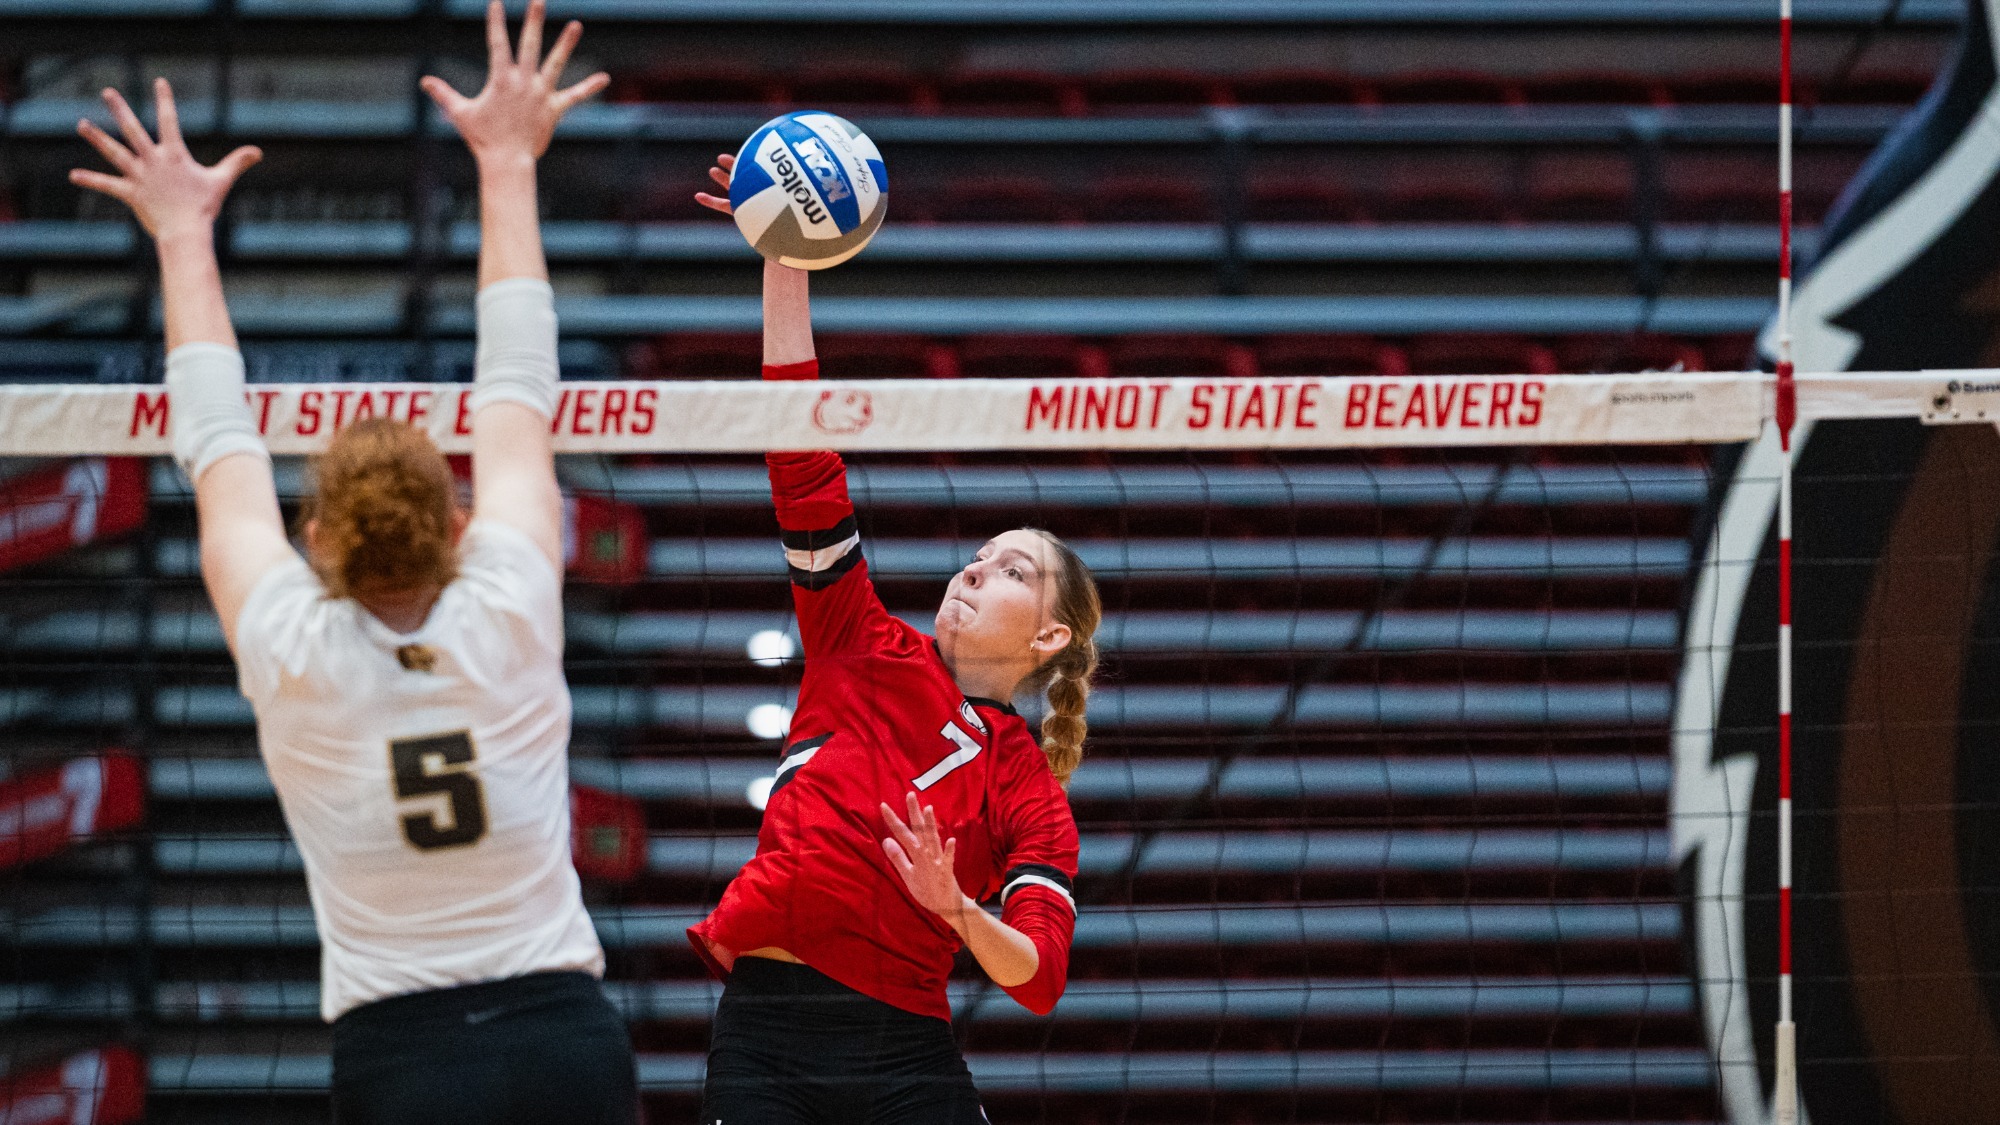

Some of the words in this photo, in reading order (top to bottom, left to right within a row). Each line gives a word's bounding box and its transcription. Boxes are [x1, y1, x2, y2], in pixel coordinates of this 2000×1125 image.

[769, 147, 827, 225] molten
[791, 136, 851, 203] NCAA
[454, 388, 659, 435] BVERS
[1025, 384, 1171, 430] MINOT
[1187, 383, 1321, 430] STATE
[1344, 382, 1546, 429] BEAVERS
[386, 727, 489, 853] 5
[910, 719, 983, 792] 7
